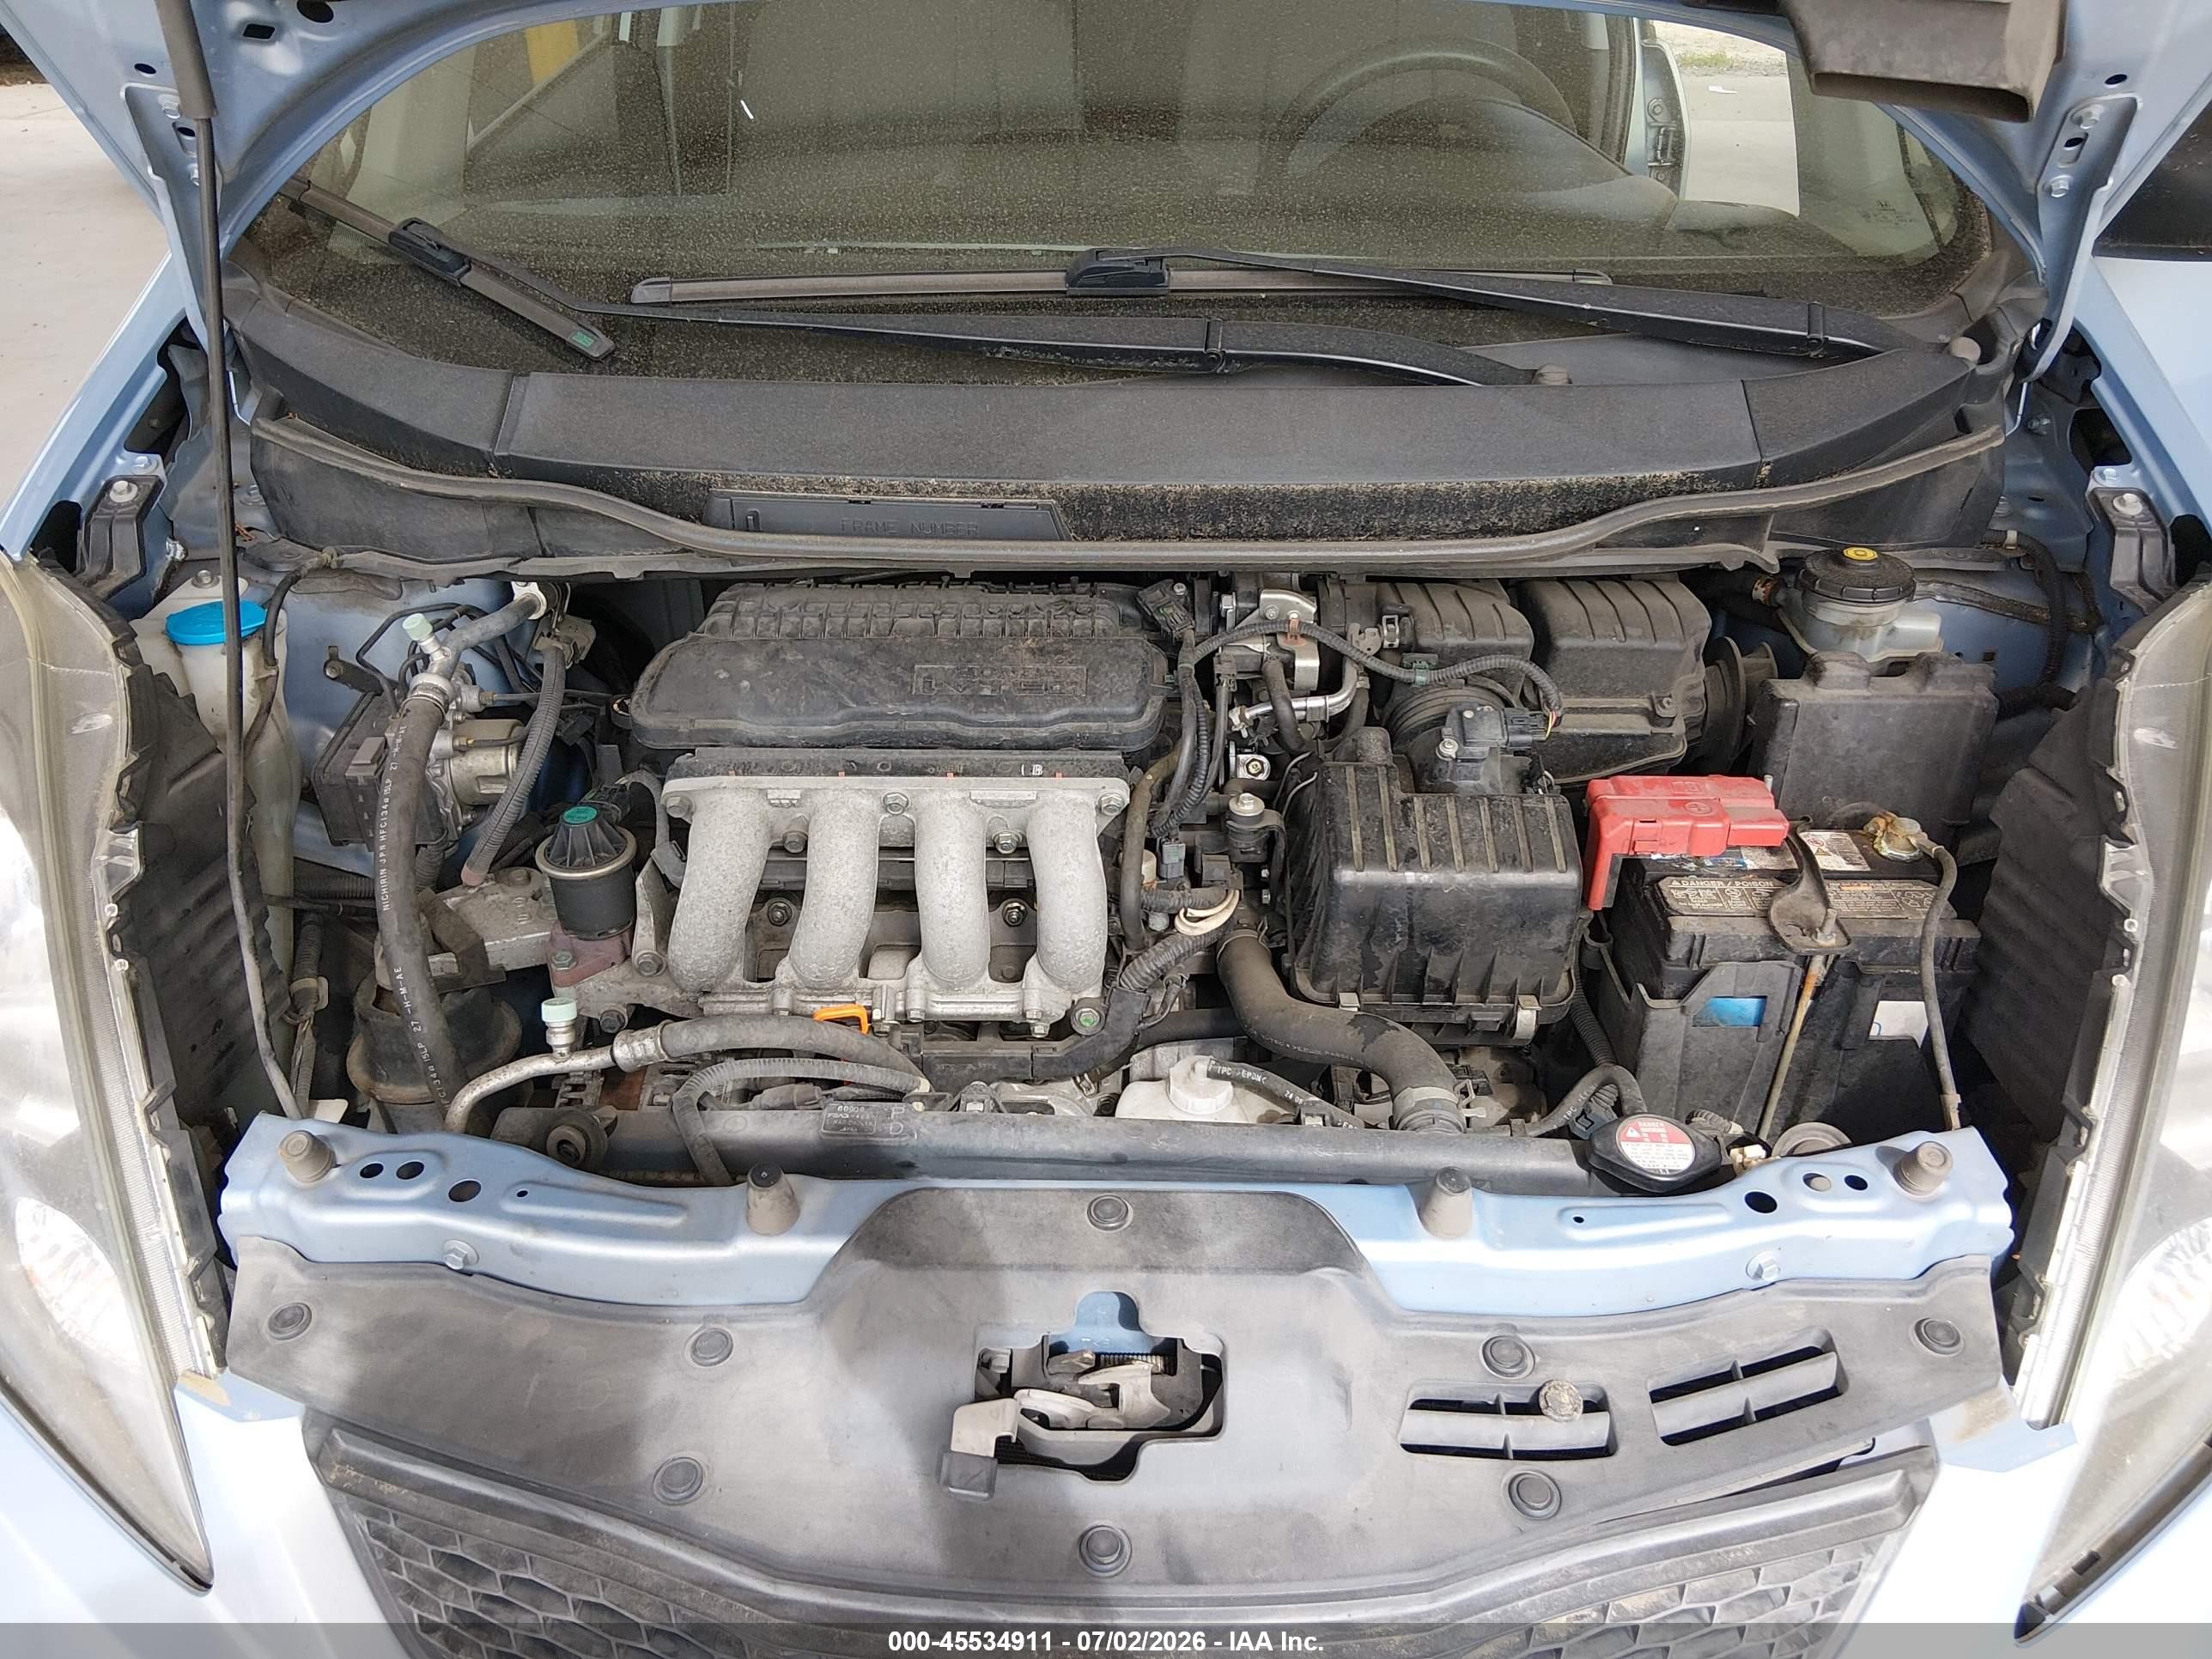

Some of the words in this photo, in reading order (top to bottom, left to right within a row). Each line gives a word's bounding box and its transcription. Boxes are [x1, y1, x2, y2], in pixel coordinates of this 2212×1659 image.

[840, 518, 898, 535] FRAME
[910, 521, 979, 537] NUMBER
[379, 844, 387, 864] JPN
[379, 867, 391, 911] NICHIRIN
[410, 1020, 422, 1032] 27
